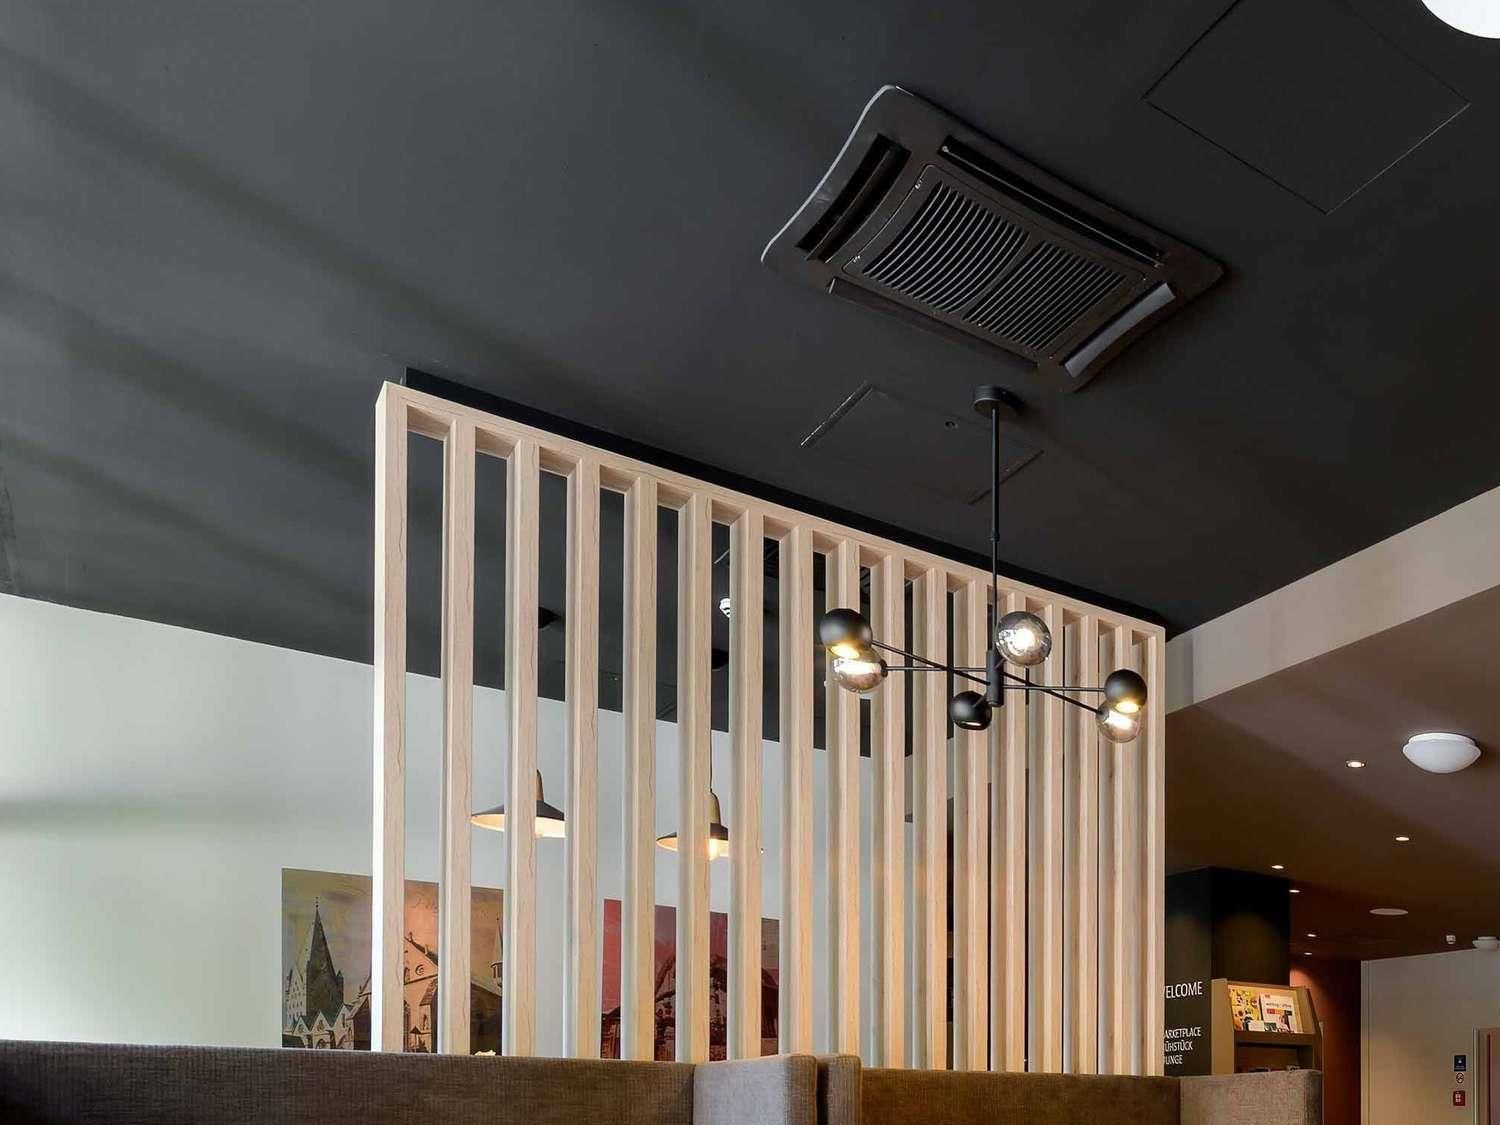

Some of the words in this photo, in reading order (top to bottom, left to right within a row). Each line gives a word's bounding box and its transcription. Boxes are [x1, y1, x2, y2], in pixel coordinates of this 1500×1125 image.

[1165, 981, 1203, 998] ELCOME
[1164, 1026, 1202, 1039] ARKETPLACE
[1164, 1039, 1193, 1052] ÜHSTÜCK
[1164, 1055, 1183, 1065] UNGE
